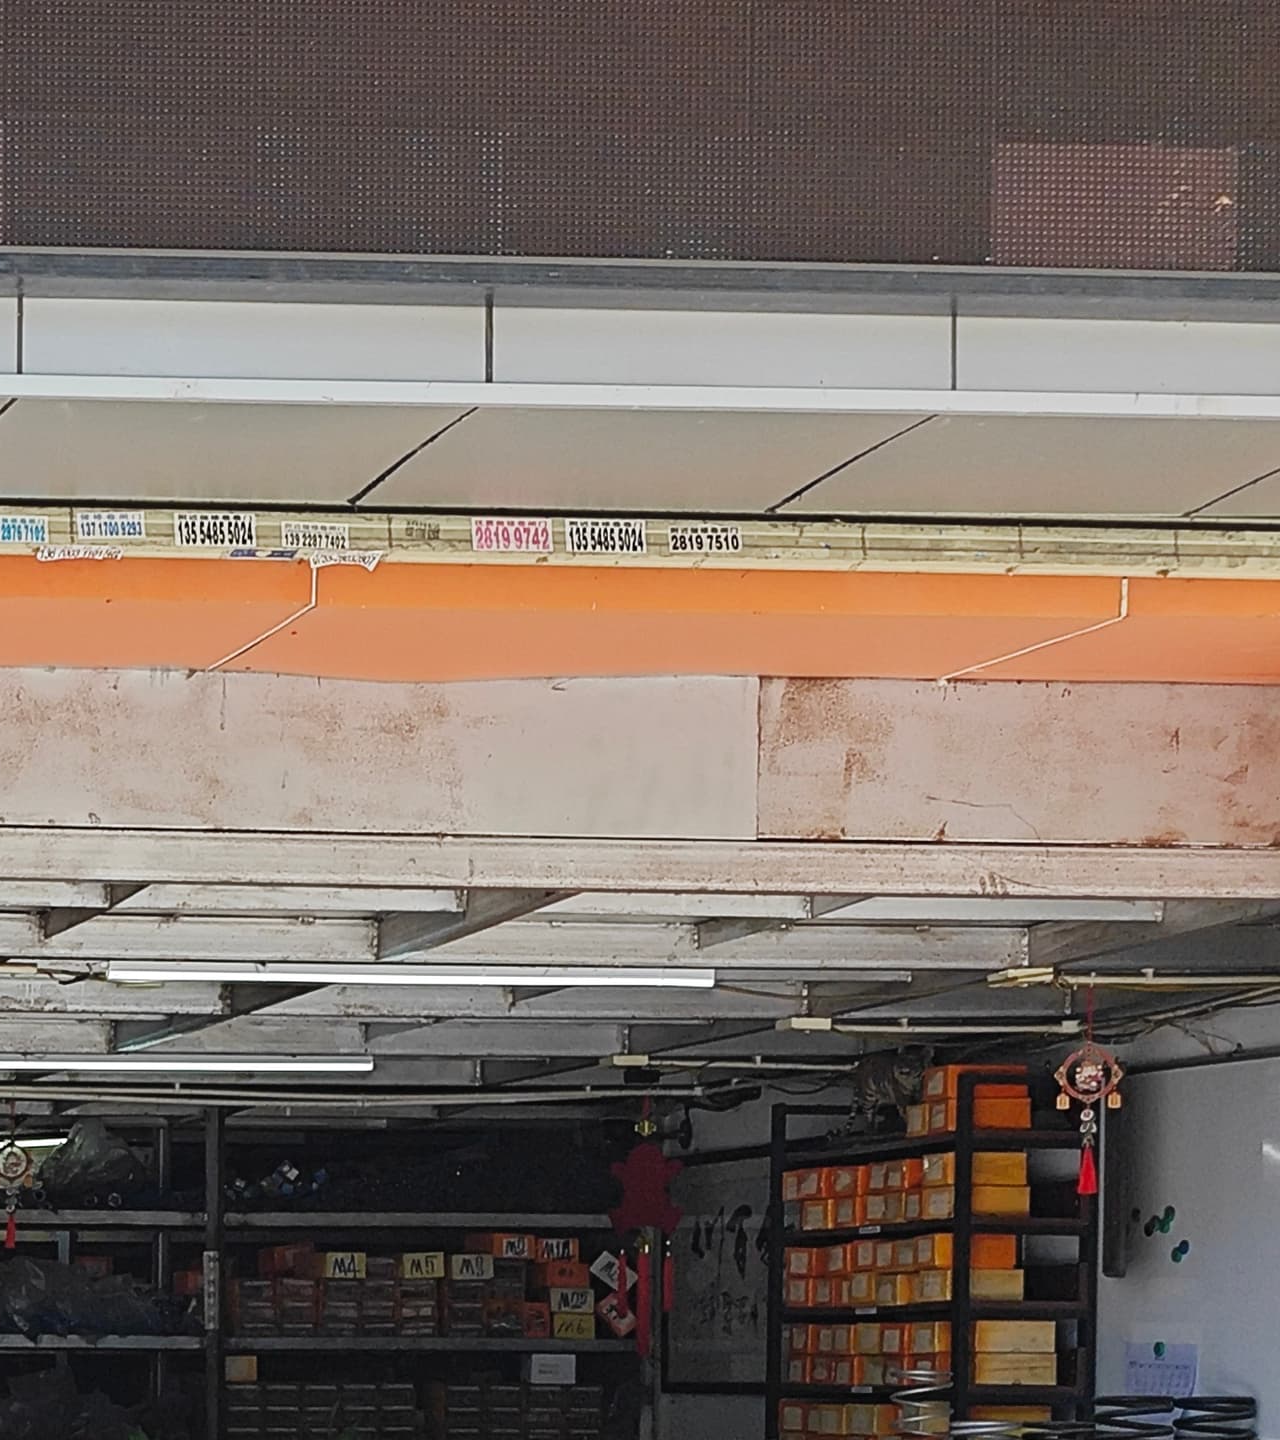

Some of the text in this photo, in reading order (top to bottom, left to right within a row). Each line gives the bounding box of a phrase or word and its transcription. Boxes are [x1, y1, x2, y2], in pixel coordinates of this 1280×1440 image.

[81, 521, 142, 536] 137 1700 9293
[178, 522, 253, 545] 135 5485 5024
[476, 527, 549, 550] 2819 9742
[569, 528, 644, 552] 135 5485 5024
[672, 535, 739, 551] 2819 7510
